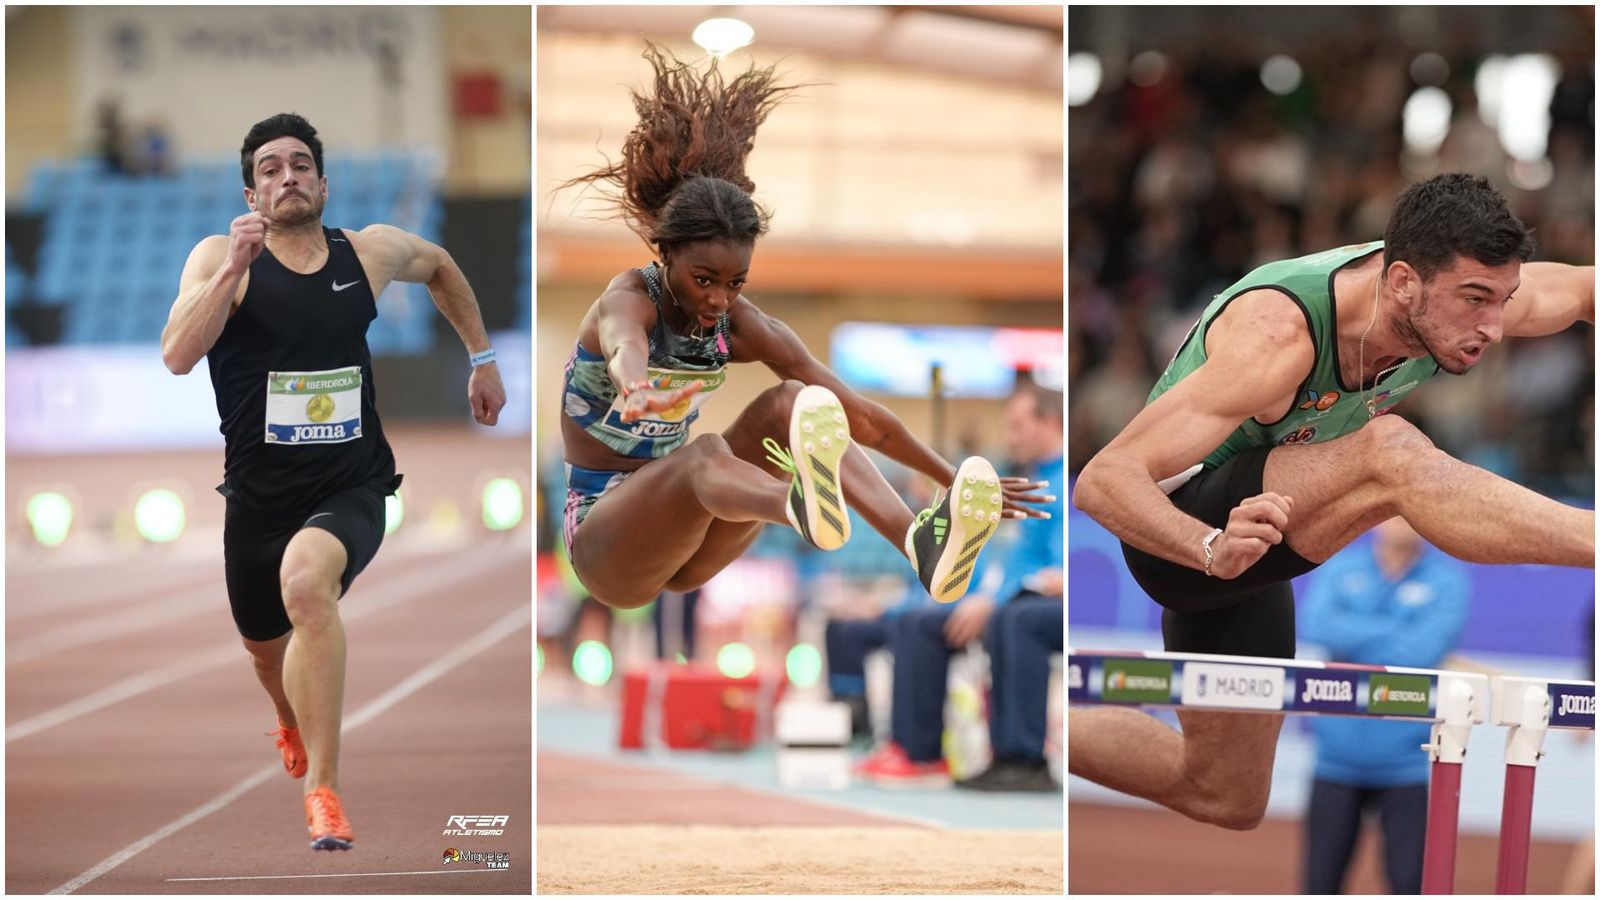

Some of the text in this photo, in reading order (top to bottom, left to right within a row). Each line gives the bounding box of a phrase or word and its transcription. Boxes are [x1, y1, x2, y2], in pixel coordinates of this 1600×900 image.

[306, 377, 353, 389] IBERDROLA
[669, 379, 721, 388] IBEROLA
[1215, 677, 1274, 697] MADRID
